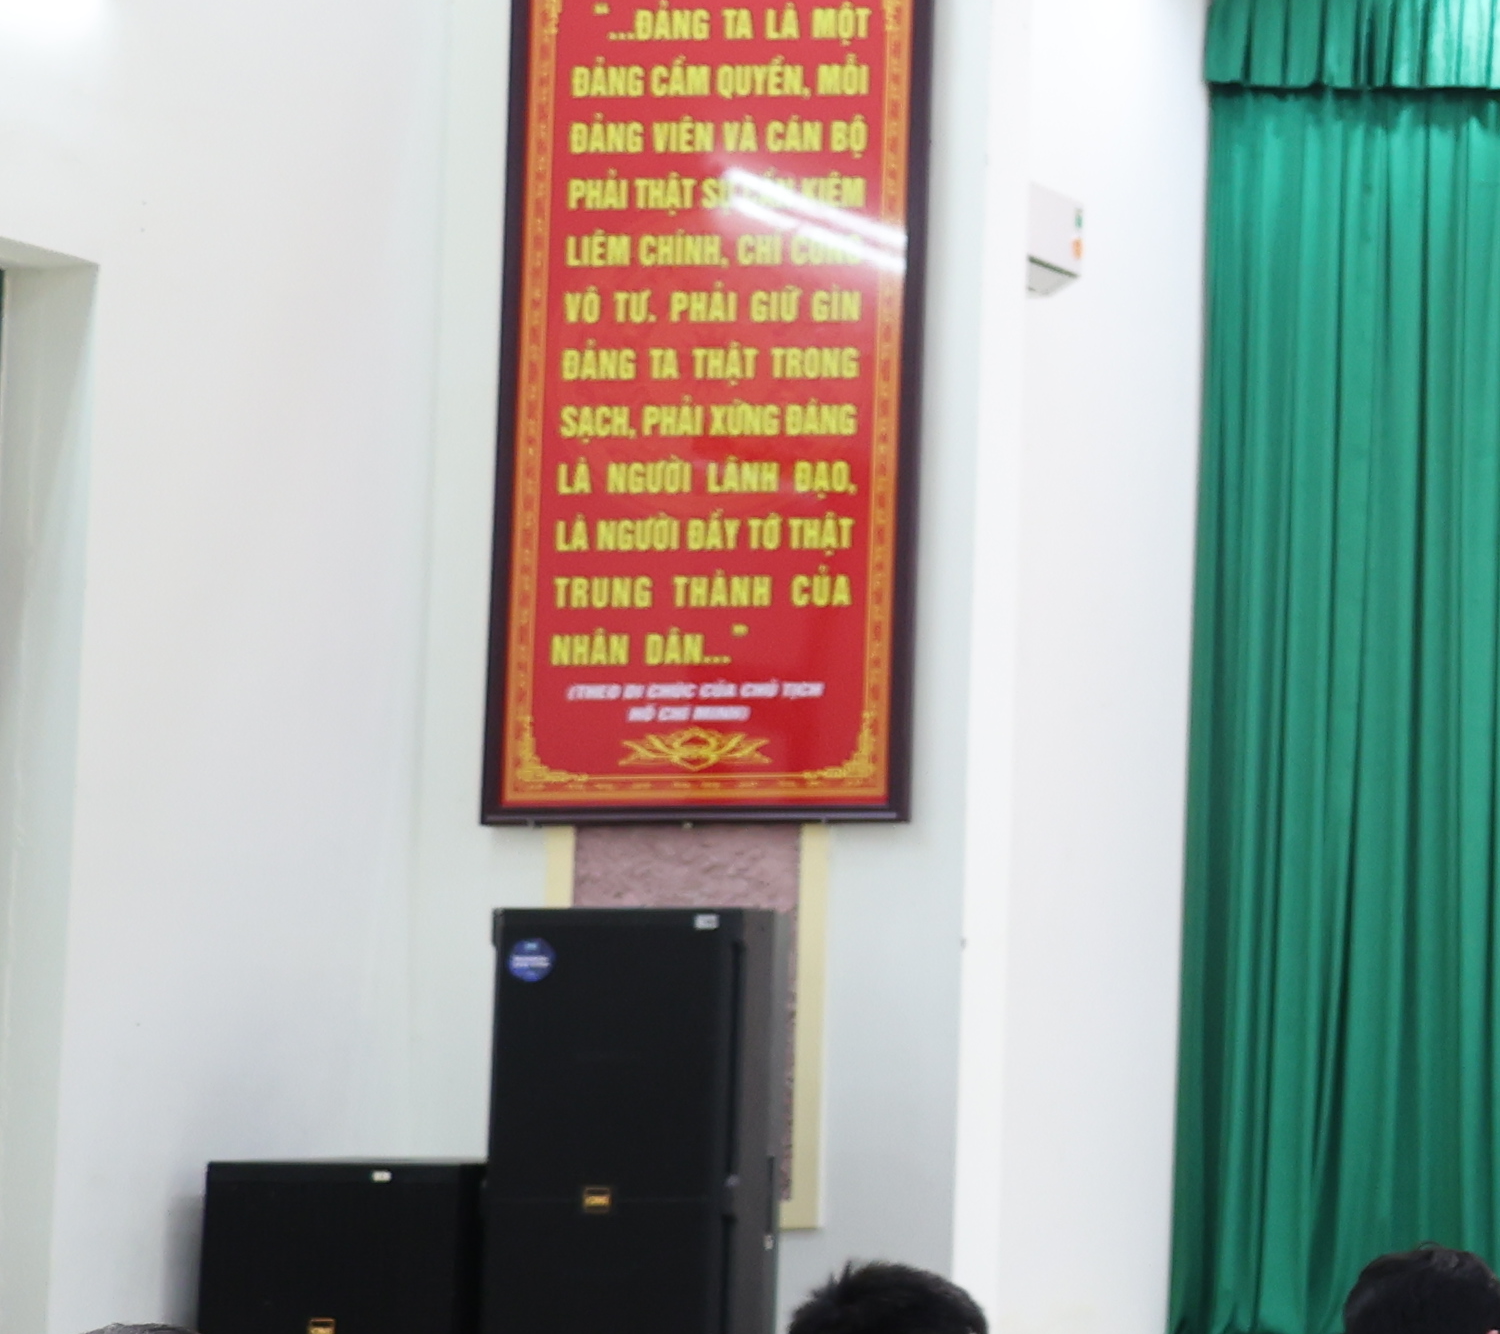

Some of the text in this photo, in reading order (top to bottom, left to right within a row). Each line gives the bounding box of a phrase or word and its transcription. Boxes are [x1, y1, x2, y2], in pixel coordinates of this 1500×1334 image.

[721, 7, 754, 40] TA
[648, 347, 680, 380] TA
[770, 346, 860, 380] TRONG
[553, 575, 653, 609] TRUNG
